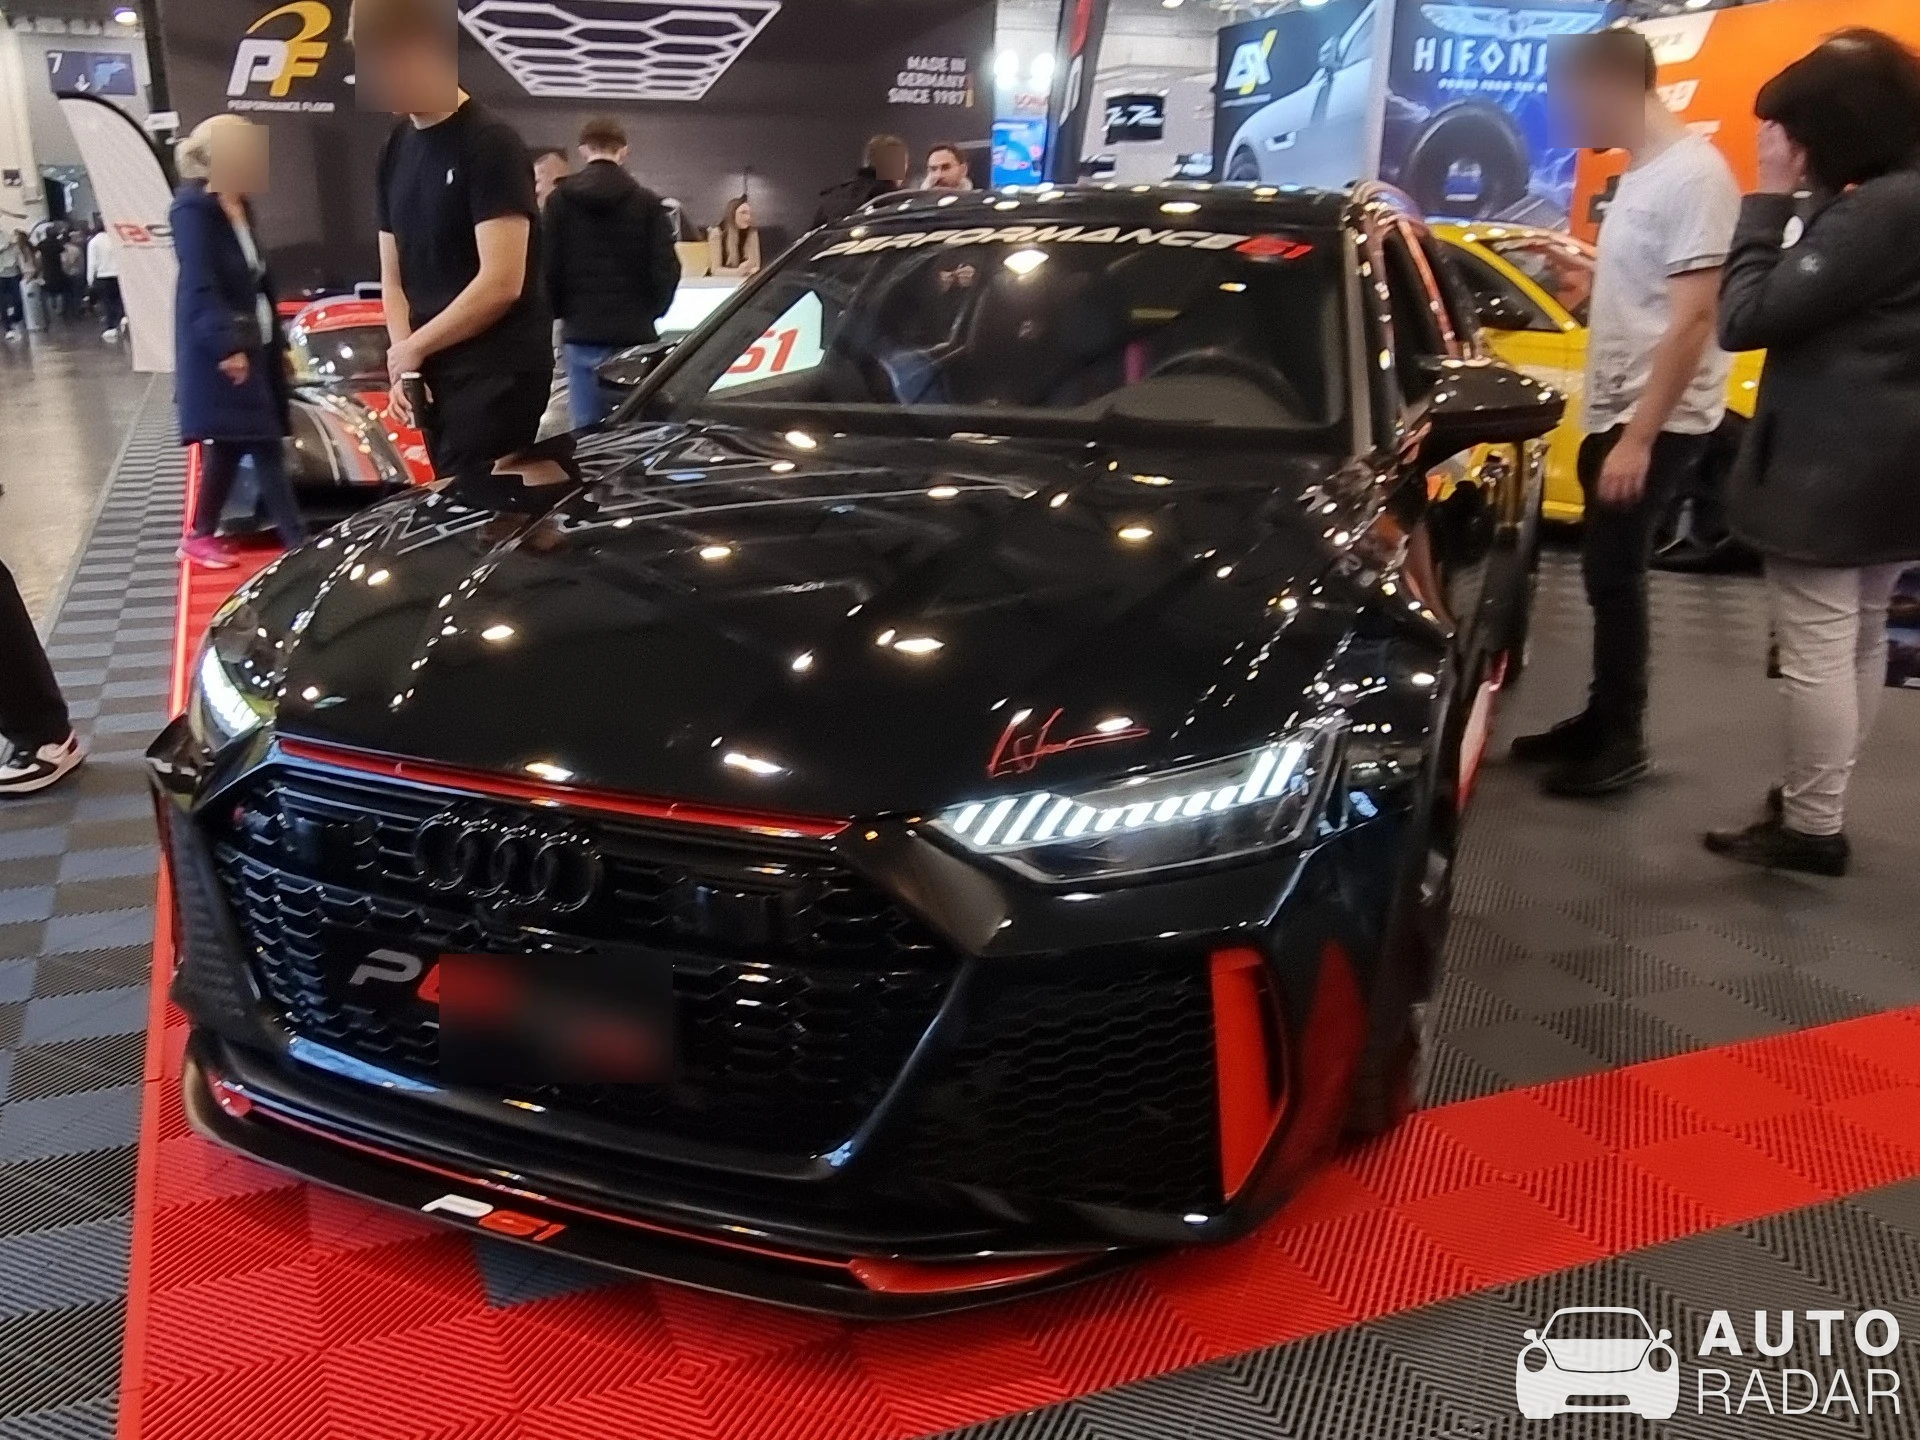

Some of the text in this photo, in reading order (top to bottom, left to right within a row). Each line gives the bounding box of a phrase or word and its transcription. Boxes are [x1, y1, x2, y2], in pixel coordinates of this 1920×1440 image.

[47, 52, 63, 74] 7
[907, 56, 967, 72] MADE IN
[1413, 37, 1548, 76] HIFONI
[896, 71, 967, 88] GERMANY
[888, 88, 931, 104] SINCE
[809, 226, 1250, 262] PERFORMANCE
